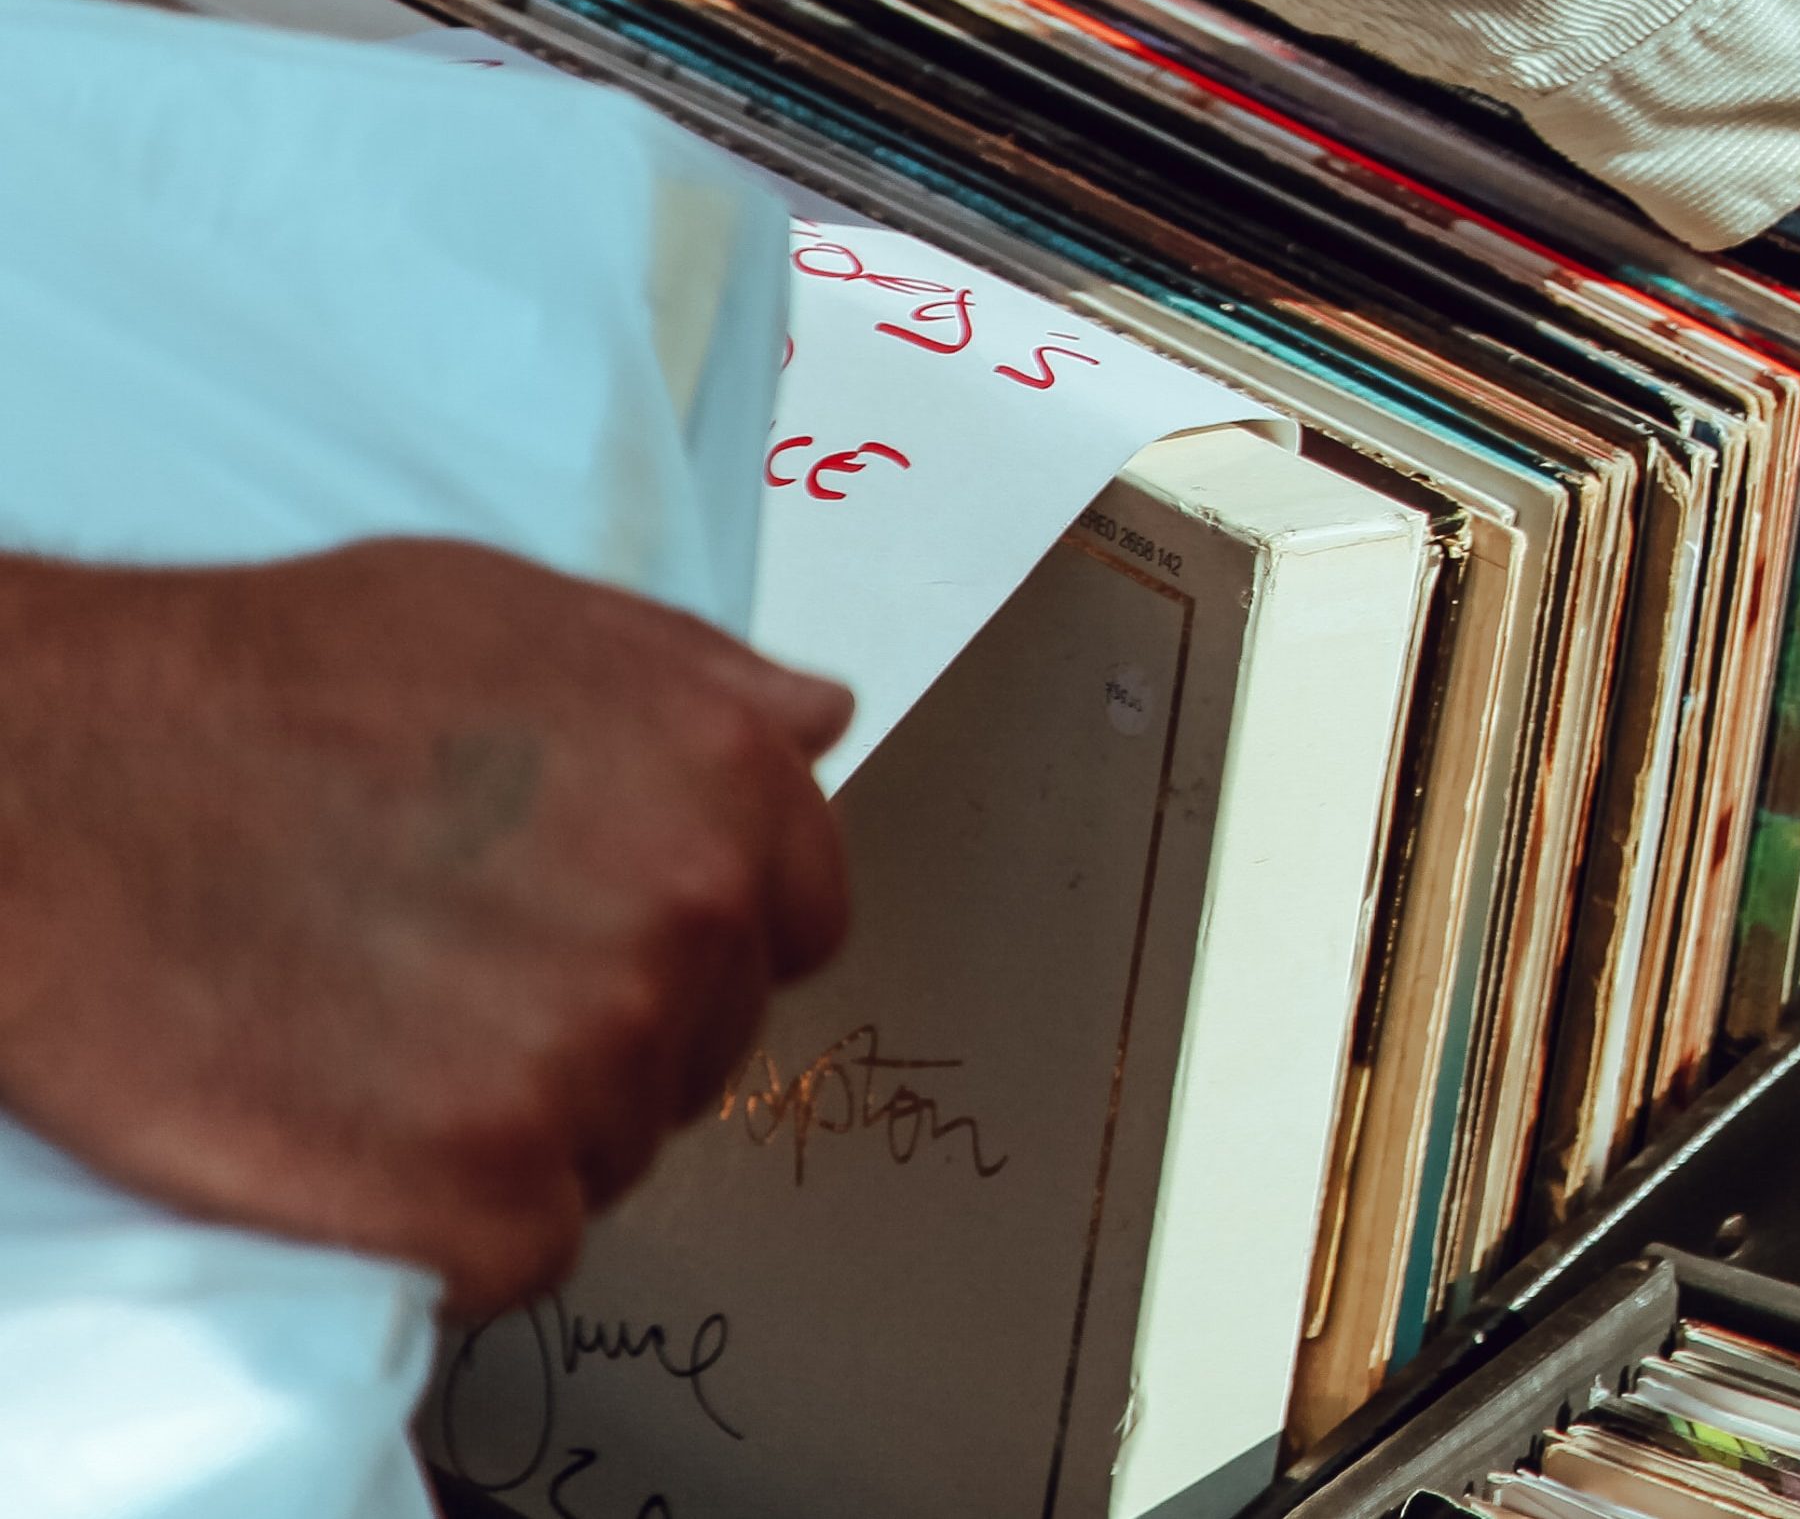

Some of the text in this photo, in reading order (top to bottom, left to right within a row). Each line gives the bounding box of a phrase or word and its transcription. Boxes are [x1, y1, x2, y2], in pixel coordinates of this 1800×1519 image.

[1080, 508, 1183, 578] EREO 2658 142
